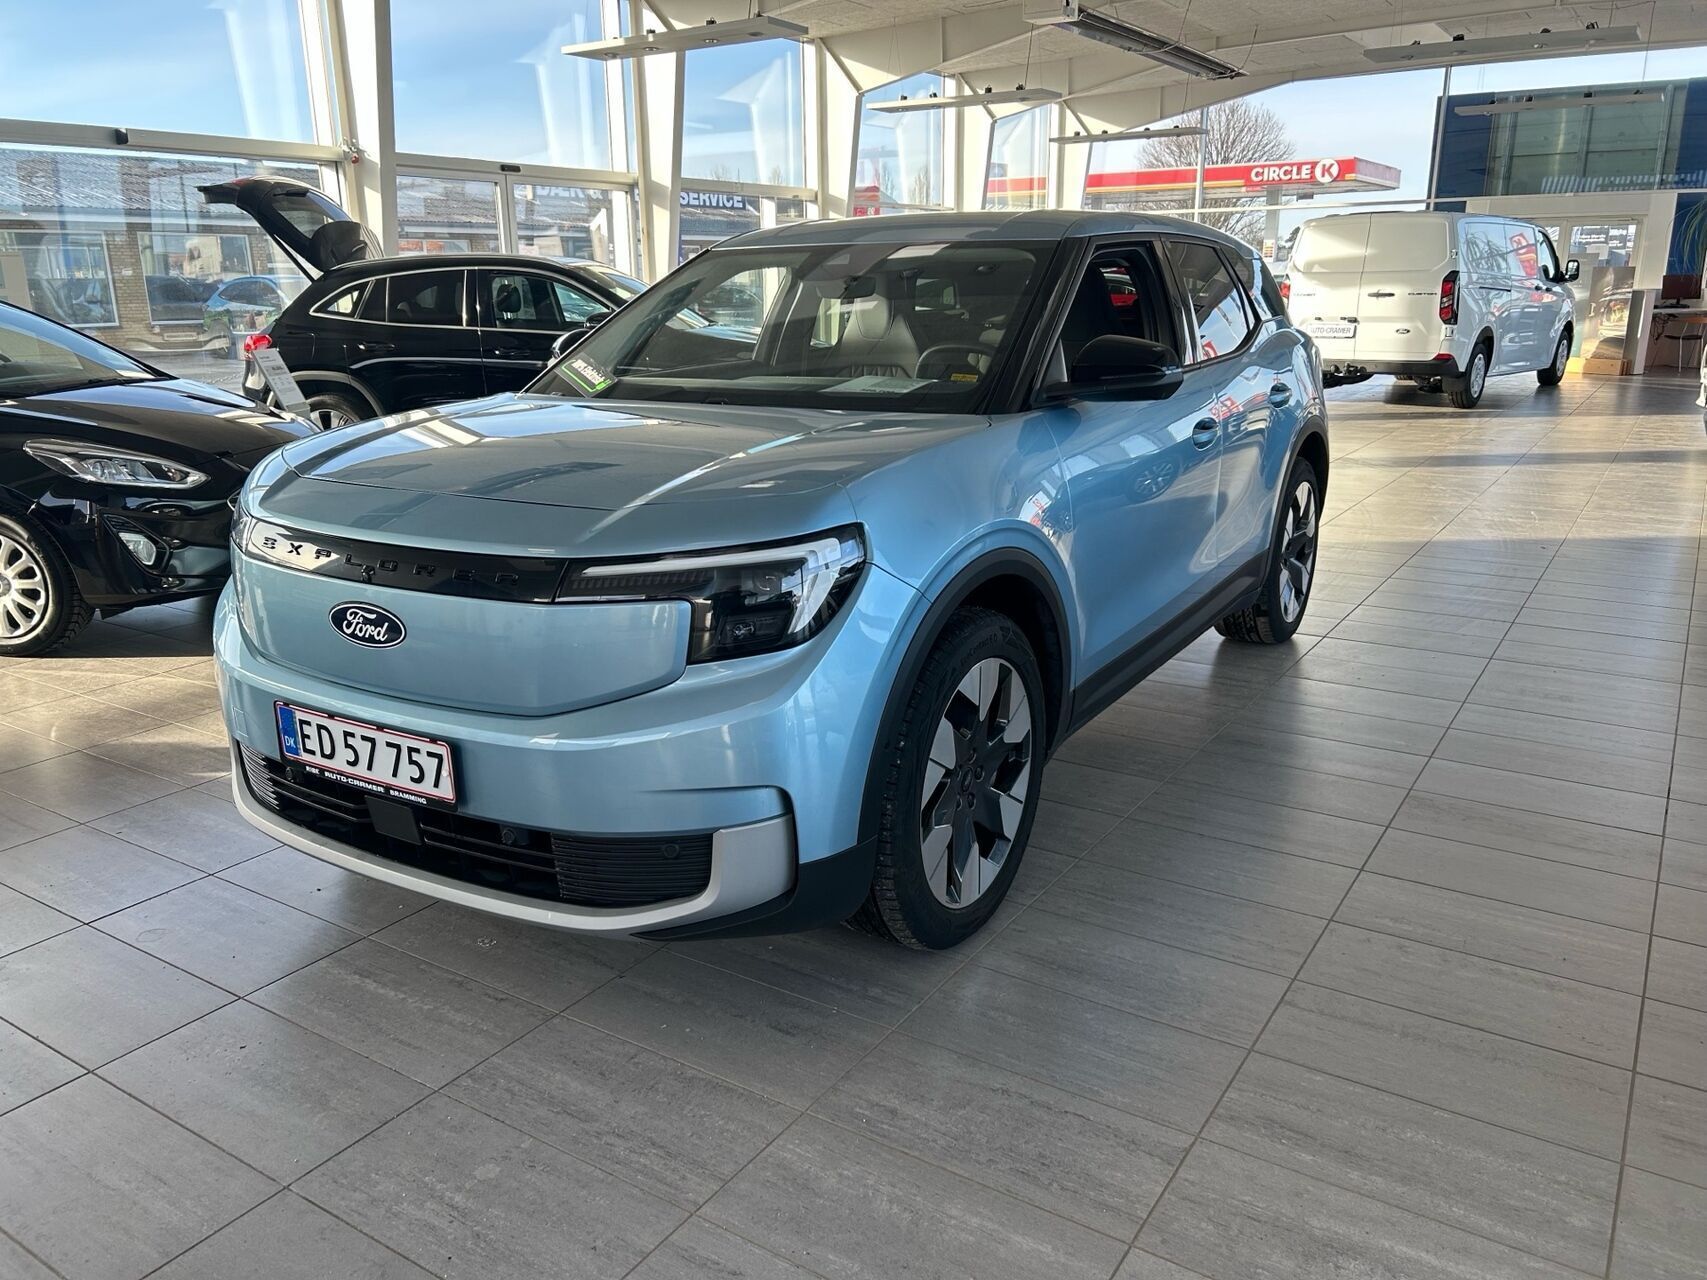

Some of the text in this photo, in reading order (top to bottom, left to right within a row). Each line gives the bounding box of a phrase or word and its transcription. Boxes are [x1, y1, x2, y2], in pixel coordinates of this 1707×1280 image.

[1251, 164, 1311, 182] CIRCLE
[680, 191, 743, 208] SERVICE
[262, 536, 519, 585] EXPLORER
[343, 607, 389, 642] Ford
[284, 735, 297, 749] DK
[298, 718, 444, 789] ED 57 757
